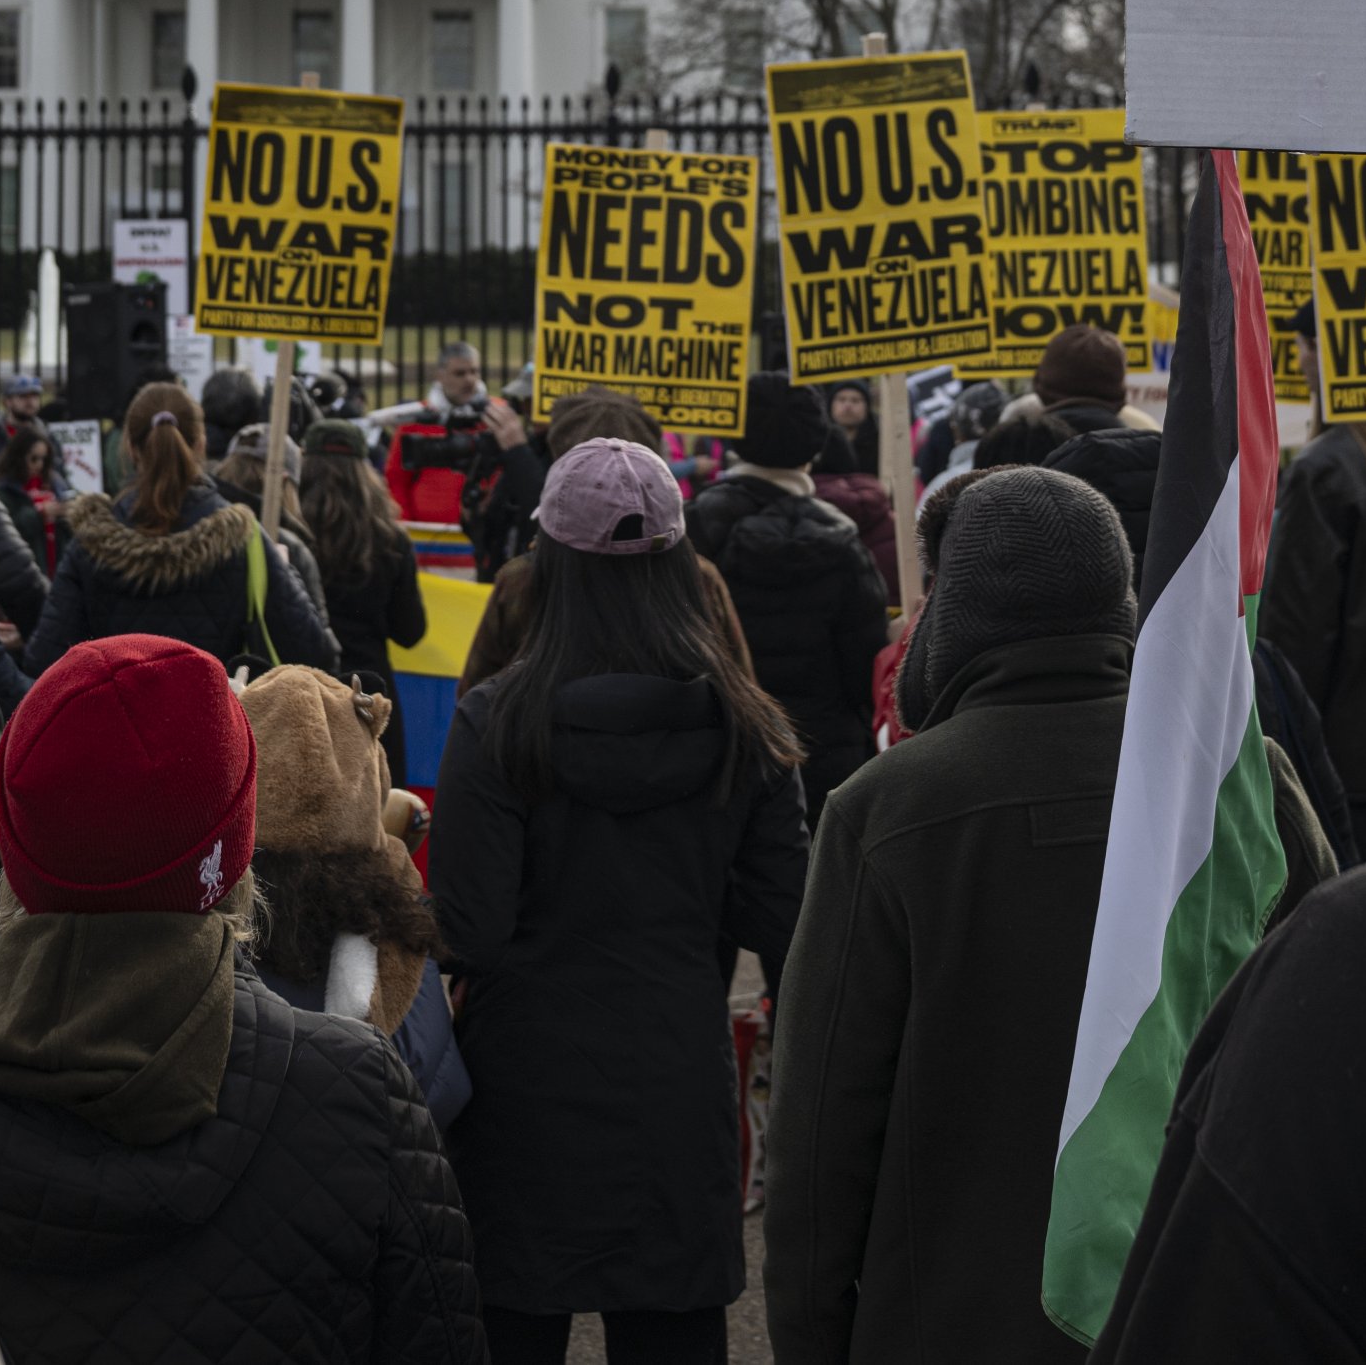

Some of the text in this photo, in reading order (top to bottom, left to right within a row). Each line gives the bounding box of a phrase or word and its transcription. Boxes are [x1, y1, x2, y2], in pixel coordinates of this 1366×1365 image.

[996, 118, 1077, 132] TRUMP
[211, 128, 393, 215] NO U.S.
[554, 148, 751, 176] MONEY FOR
[554, 167, 750, 197] PEOPLE'S
[778, 107, 979, 216] NO U.S.
[985, 177, 1139, 237] OMBING
[207, 214, 391, 262] WAR
[281, 249, 313, 262] ON
[547, 189, 746, 289] NEEDS
[786, 213, 984, 275] WAR
[204, 254, 381, 312] VENEZUELA
[874, 259, 910, 275] ON
[990, 248, 1144, 299] NEZUELA
[543, 290, 694, 332] NOT
[790, 261, 989, 341] VENEZUELA
[692, 321, 744, 335] THE
[543, 327, 742, 382] WAR MACHINE
[800, 348, 835, 372] PARTY
